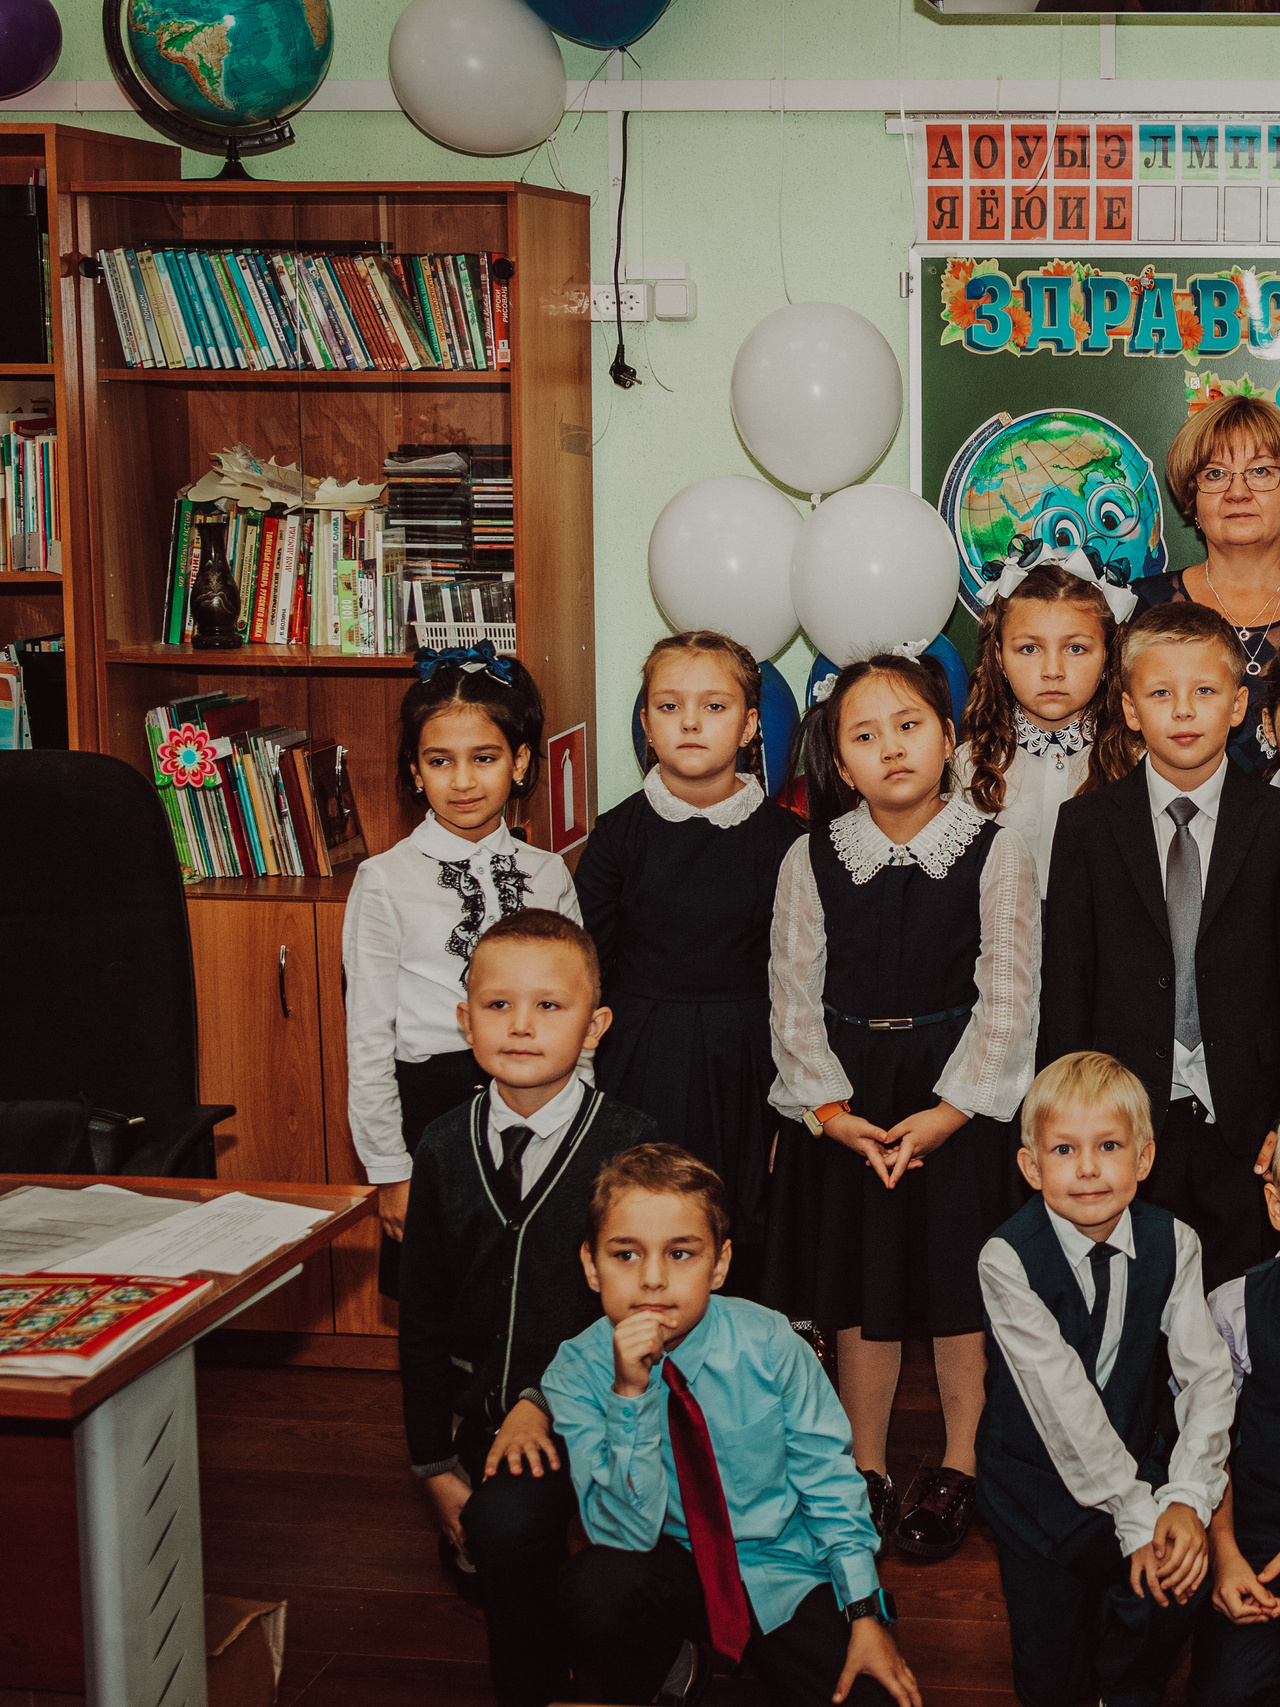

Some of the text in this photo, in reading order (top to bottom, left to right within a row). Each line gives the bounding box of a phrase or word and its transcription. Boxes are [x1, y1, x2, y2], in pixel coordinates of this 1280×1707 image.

[139, 294, 151, 321] ЛОНДОН
[257, 279, 286, 342] ОСОБЕННЫЙ
[183, 510, 191, 536] РАСТЕНИЙ
[286, 526, 296, 555] МОСКВА
[180, 544, 188, 573] ЖИВОТНЫХ
[255, 531, 273, 638] ТОЛКОВЫЙ СЛОВАРЬ РУССКОГО ЯЗЫКА
[270, 573, 280, 626] ОРФОГРАФИЧЕСКИЙ
[340, 599, 353, 620] 1000
